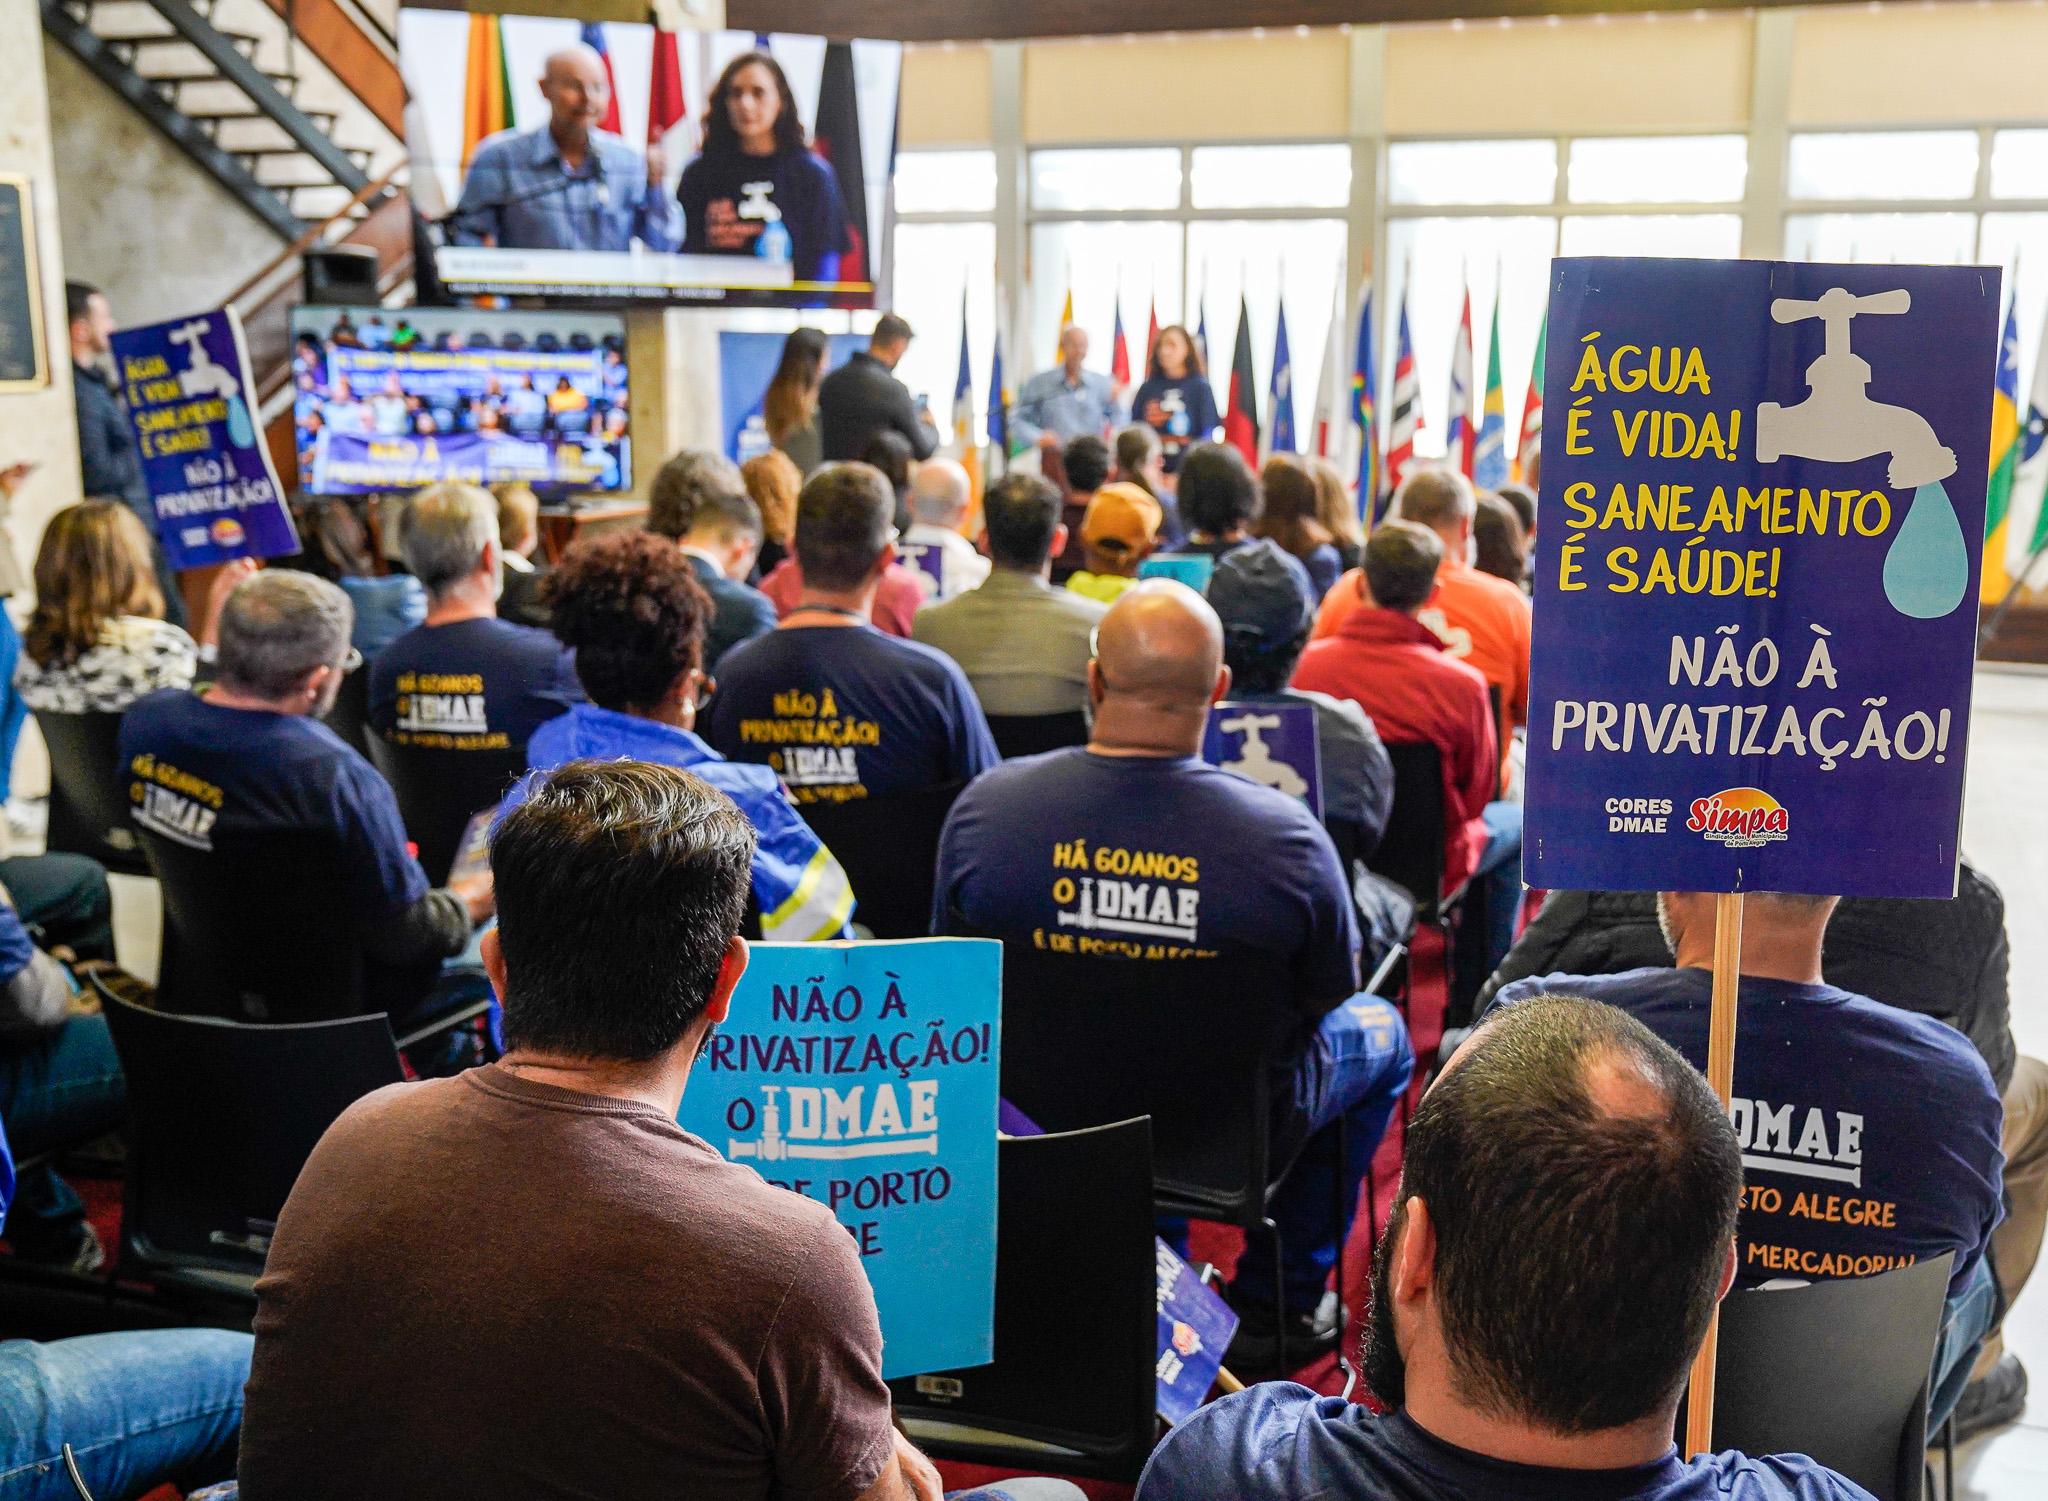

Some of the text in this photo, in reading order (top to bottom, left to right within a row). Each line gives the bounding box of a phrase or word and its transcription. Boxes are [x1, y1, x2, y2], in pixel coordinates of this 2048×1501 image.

[1569, 331, 1711, 395] ÁGUA
[1566, 396, 1742, 461] É VIDA!
[1563, 481, 1892, 537] SANEAMENTO
[1559, 532, 1782, 598] É SAÚDE!
[1668, 623, 1838, 690] NÃO À
[773, 688, 817, 718] NÃO
[740, 716, 880, 747] PRIVATIZAÇÃO!
[1551, 695, 1952, 771] PRIVATIZAÇÃO!
[794, 746, 859, 774] DMAE
[1605, 797, 1789, 839] CORES Simpa
[1608, 816, 1668, 833] DMAE
[1053, 838, 1089, 871] HÁ
[1052, 876, 1200, 928] O DMAE
[772, 970, 908, 1022] NÃO À
[709, 1019, 991, 1079] RIVATIZAÇÃO!
[726, 1079, 939, 1140] O DMAE
[1731, 1097, 1864, 1166] DMAE
[829, 1166, 951, 1212] PORTO
[1789, 1192, 1897, 1228] ALEGRE
